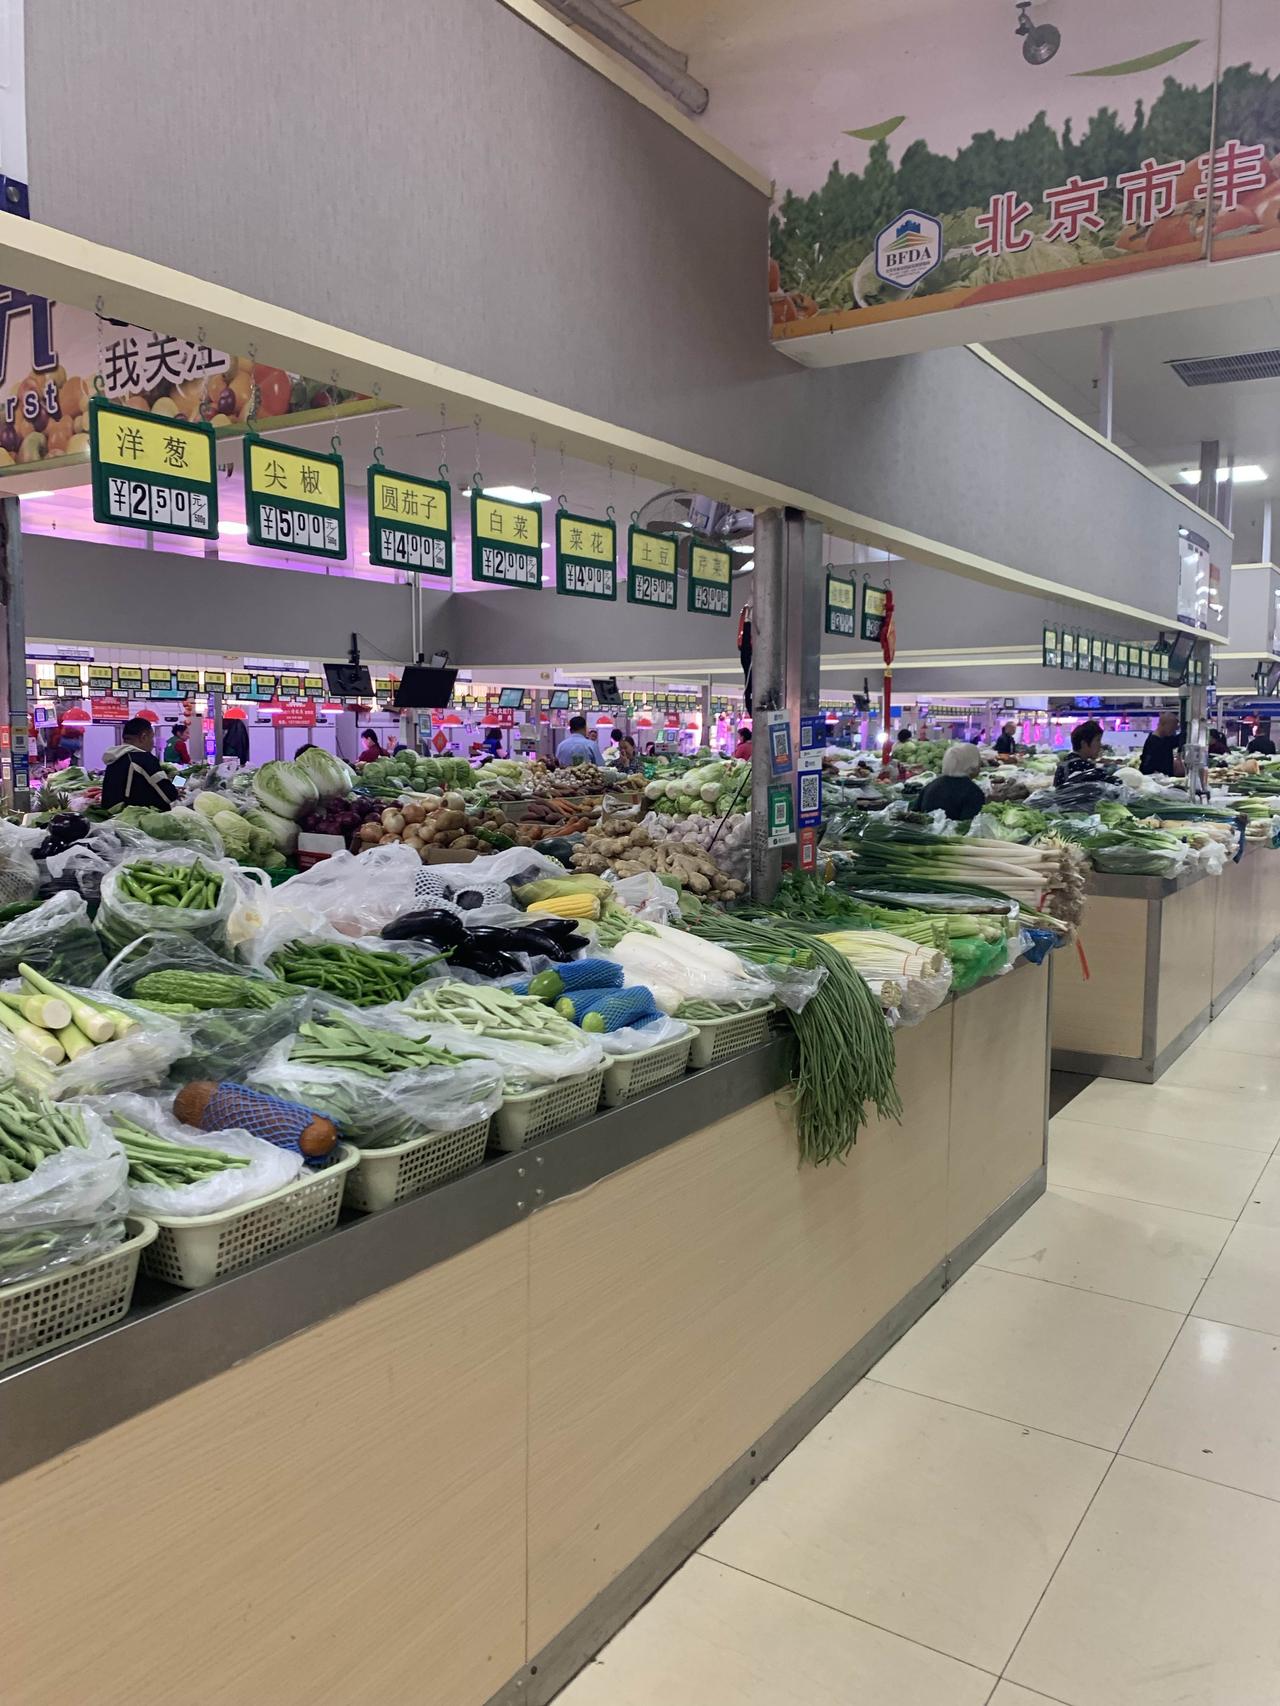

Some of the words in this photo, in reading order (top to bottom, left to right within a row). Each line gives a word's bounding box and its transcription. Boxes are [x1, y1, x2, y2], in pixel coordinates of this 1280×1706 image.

[885, 246, 932, 267] BFDA
[116, 426, 189, 468] 洋葱
[264, 460, 322, 494] 尖椒
[382, 485, 437, 519] 圆茄子
[490, 510, 528, 540] 白菜
[569, 527, 604, 554] 菜花
[641, 543, 669, 567] 土豆
